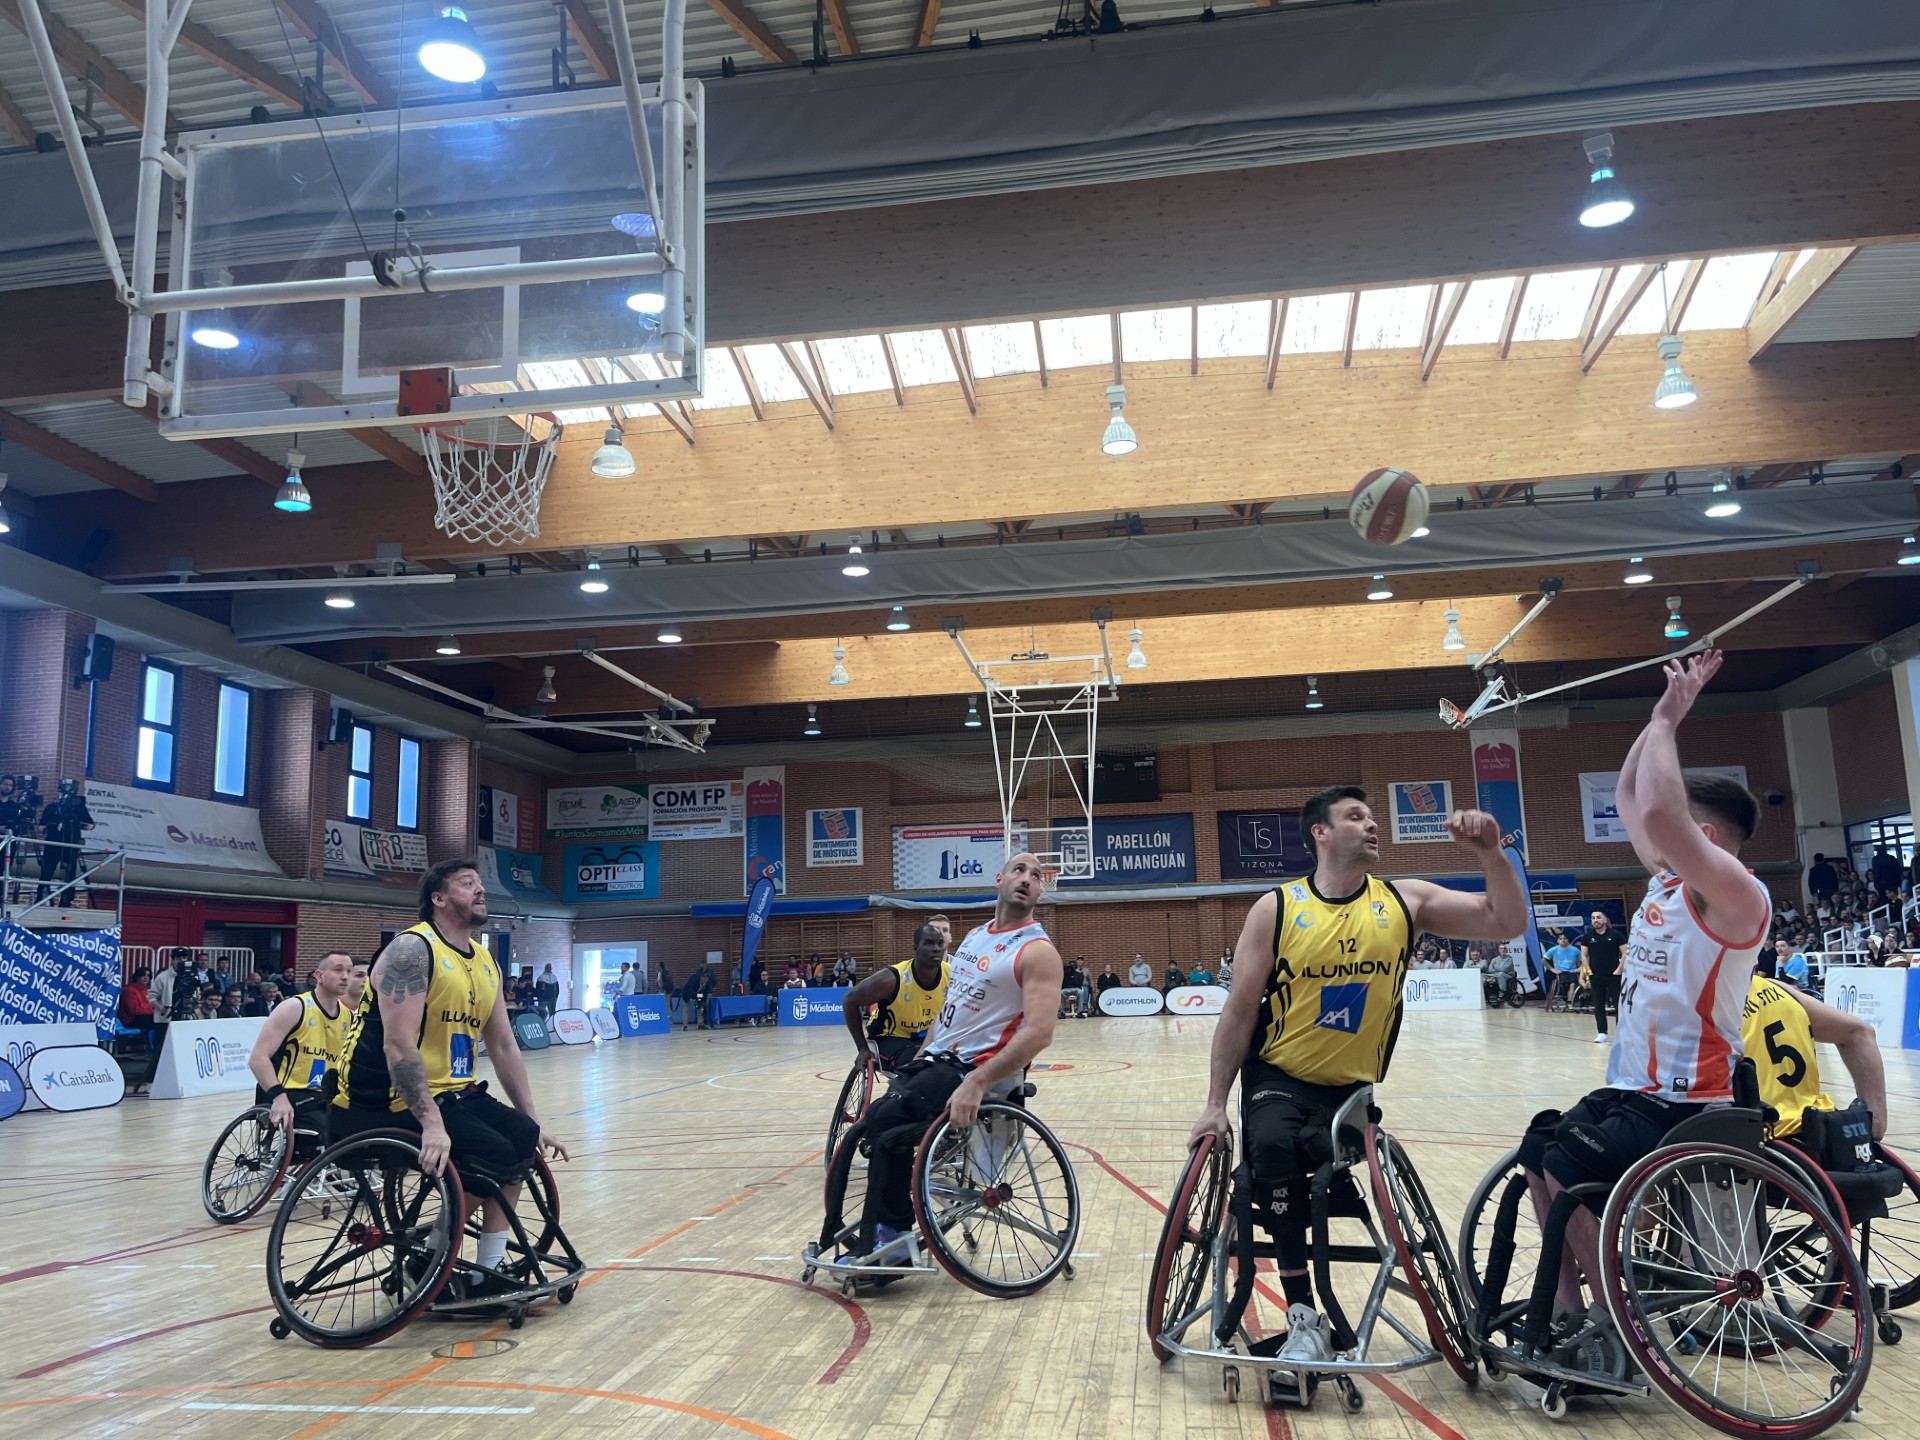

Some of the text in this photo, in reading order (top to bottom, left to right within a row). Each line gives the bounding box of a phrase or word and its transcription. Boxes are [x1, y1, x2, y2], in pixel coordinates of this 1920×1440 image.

[652, 788, 726, 808] CDM FP
[1106, 830, 1171, 850] PABELLÓN
[1399, 825, 1409, 839] DE
[813, 850, 822, 859] DE
[1095, 850, 1186, 871] EVA MANGUÁN
[2, 927, 63, 978] Móstoles
[1338, 938, 1357, 955] 12
[1300, 960, 1391, 979] ILUNION
[31, 971, 84, 1018] Móstoles
[60, 964, 114, 1008] Móstoles
[809, 1002, 844, 1014] Móstoles
[1115, 998, 1157, 1006] DECATHLON
[922, 1008, 932, 1017] 13
[1763, 1019, 1806, 1088] 5
[60, 1068, 115, 1087] CaixaBank
